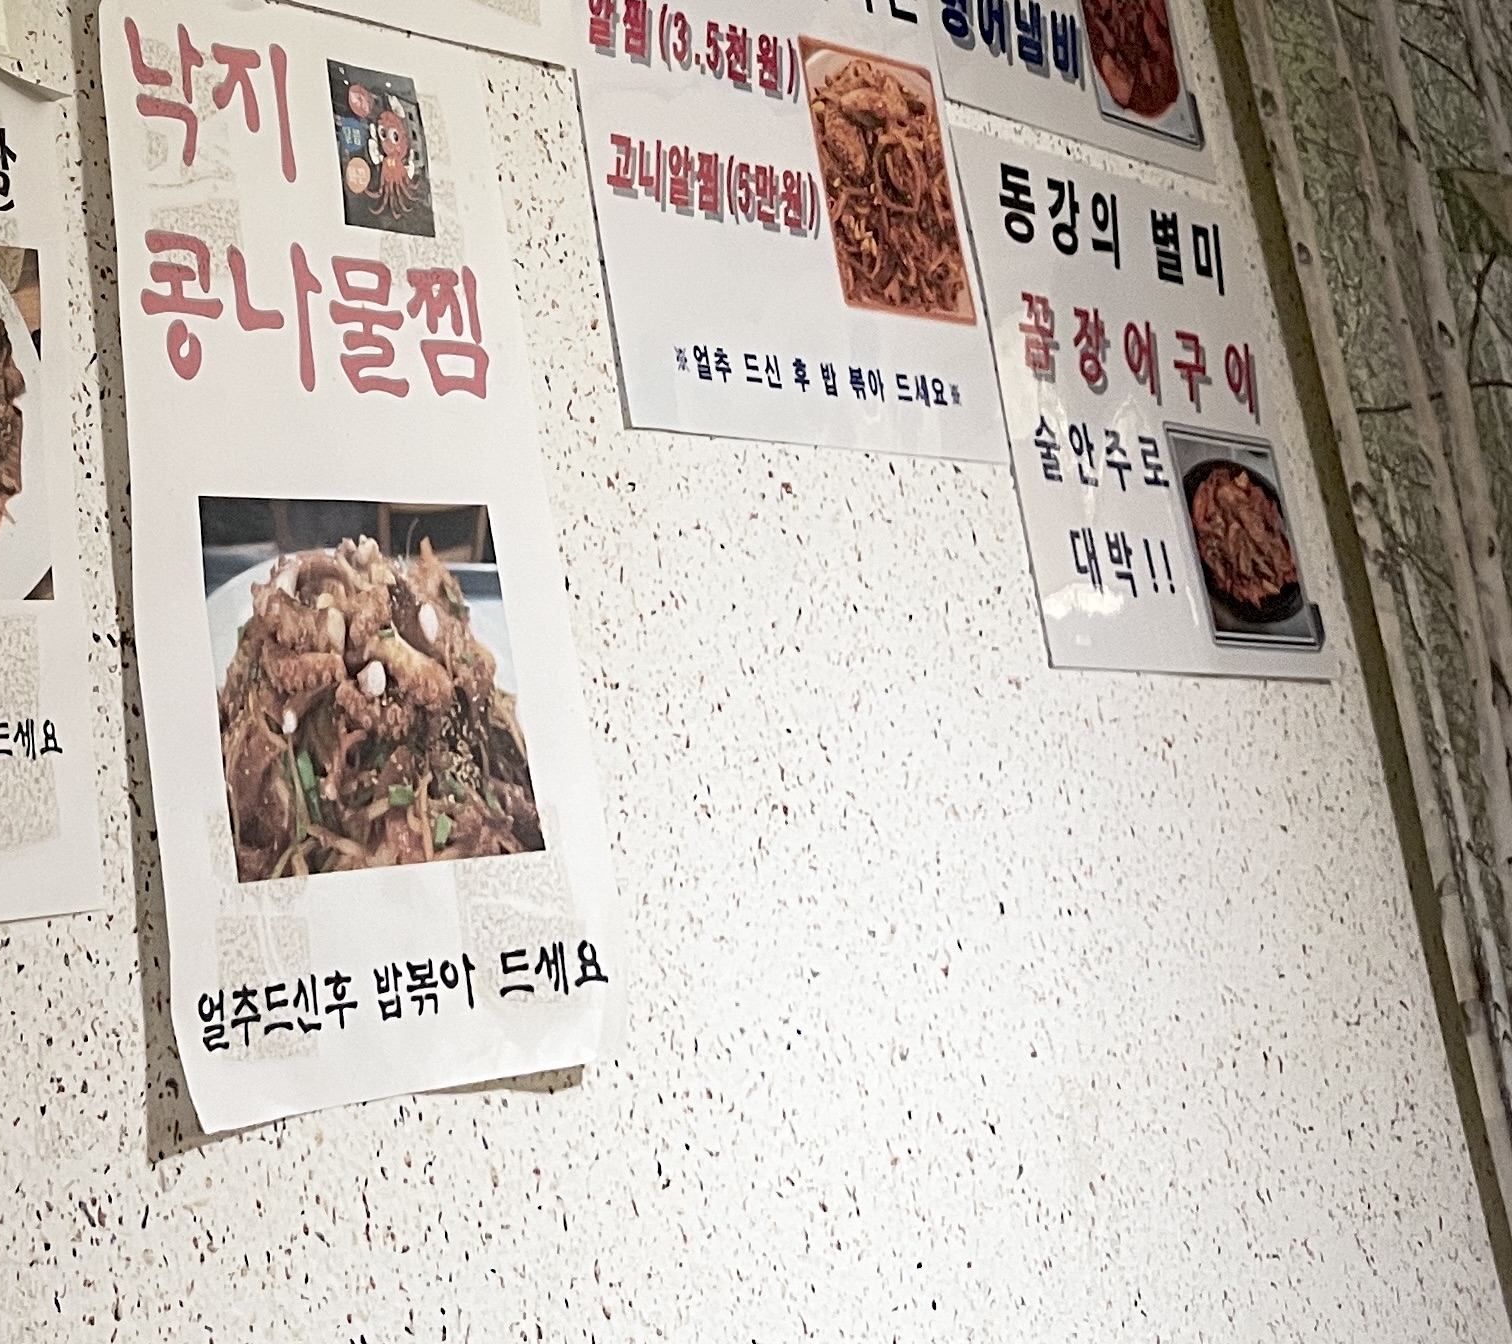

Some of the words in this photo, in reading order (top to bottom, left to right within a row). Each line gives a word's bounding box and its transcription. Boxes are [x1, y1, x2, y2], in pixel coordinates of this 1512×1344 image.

[124, 16, 296, 183] 낙지
[999, 162, 1121, 269] 동강의
[1150, 208, 1225, 296] 별미
[141, 229, 489, 399] 콩나물찜
[744, 353, 782, 389] 드신
[792, 357, 810, 392] 후
[820, 362, 838, 397] 밥
[849, 365, 885, 402] 볶아
[1034, 415, 1170, 492] 술안주로
[1070, 527, 1176, 599] 대박!!
[197, 968, 358, 1051] 얼추드신후
[374, 952, 476, 1016] 밥볶아
[499, 940, 609, 998] 드세요
